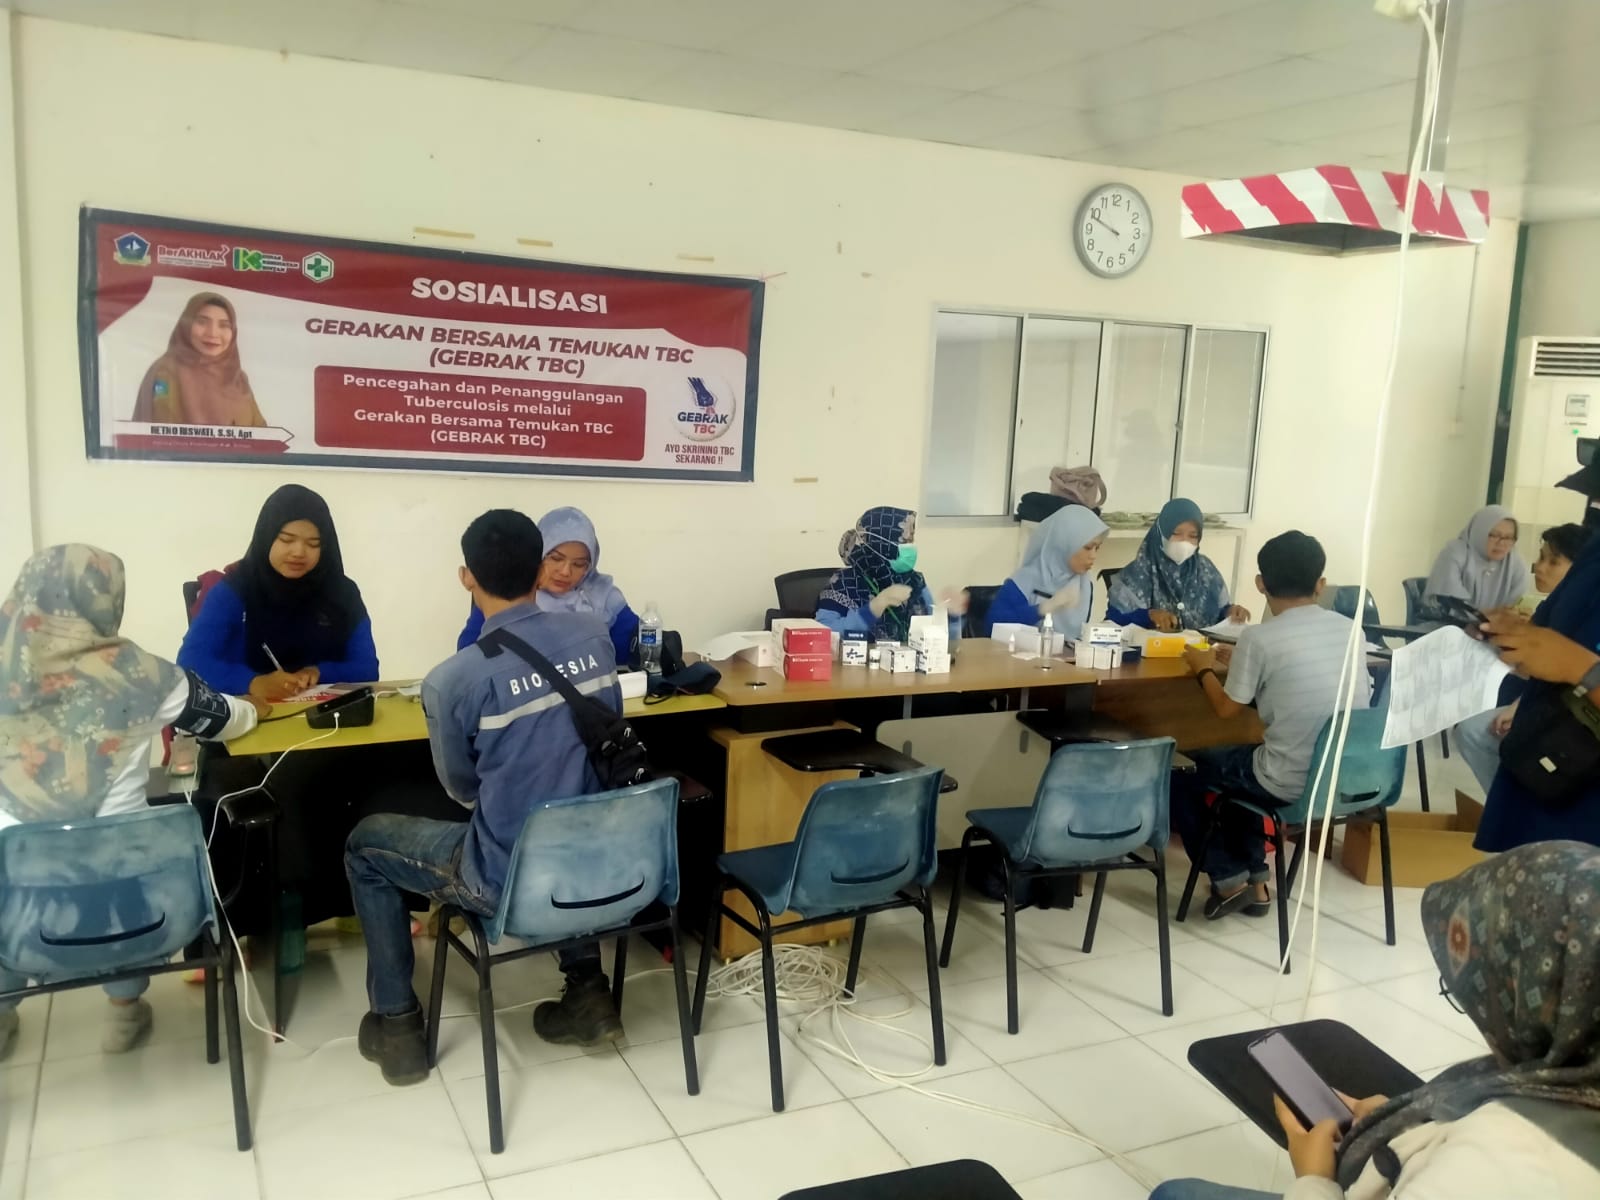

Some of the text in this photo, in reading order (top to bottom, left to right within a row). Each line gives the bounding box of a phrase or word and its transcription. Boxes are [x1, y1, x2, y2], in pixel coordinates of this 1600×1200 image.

[1101, 197, 1108, 208] 11
[1112, 194, 1122, 207] 12
[1126, 200, 1131, 212] 1
[1091, 207, 1101, 219] 10
[1131, 212, 1139, 224] 2
[1086, 222, 1093, 235] 9
[1133, 228, 1140, 240] 3
[1087, 239, 1094, 251] 8
[1128, 243, 1136, 255] 4
[1097, 251, 1103, 263] 7
[1106, 256, 1114, 268] 6
[1118, 253, 1126, 265] 5
[411, 277, 608, 314] SOSIALISASI
[305, 318, 694, 364] GERAKAN BERSAMA TEMUKAN TBC
[430, 347, 585, 379] (GEBRAK TBC)
[343, 373, 623, 405] Pencegahan dan Penanggulangan
[404, 394, 571, 416] Tuberculosis melalui
[354, 409, 614, 434] Gerakan Bersama Temukan TBC
[677, 411, 729, 425] GEBRAK
[693, 424, 717, 434] TBC
[430, 429, 546, 449] (GEBRAK TBC)
[665, 443, 735, 456] AYO SKRINING TBC
[675, 454, 716, 465] SEKARANG
[510, 653, 599, 696] BIOESIA
